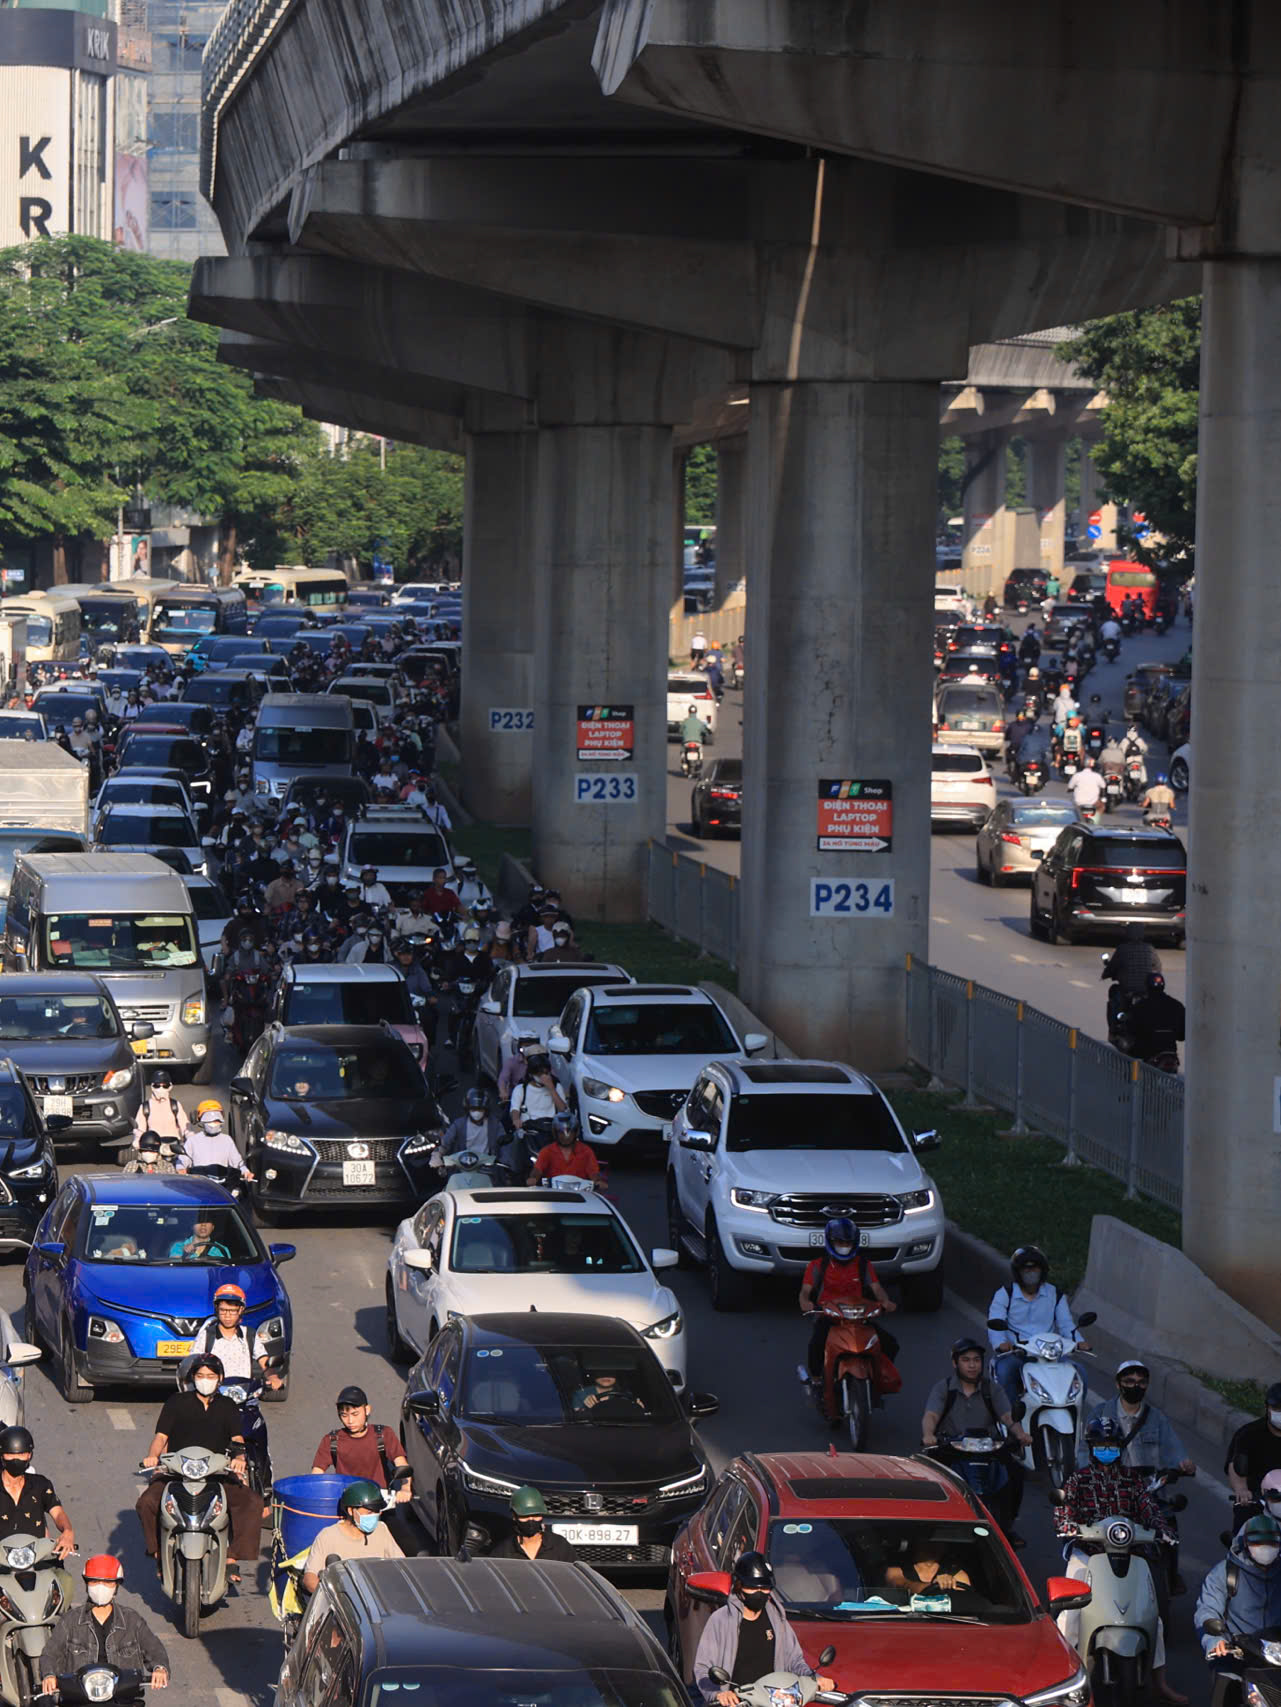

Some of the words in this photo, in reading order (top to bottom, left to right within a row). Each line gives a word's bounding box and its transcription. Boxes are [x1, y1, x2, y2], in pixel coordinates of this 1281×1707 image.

[87, 28, 110, 60] KRIK
[490, 711, 535, 729] P232
[577, 777, 635, 799] P233
[864, 786, 883, 795] Shop
[853, 801, 888, 812] THOẠI
[833, 813, 877, 822] LAPTOP
[827, 824, 851, 834] PHỤ
[815, 883, 893, 912] P234
[350, 1163, 367, 1173] 30A
[562, 1529, 630, 1541] 30K-898.27
